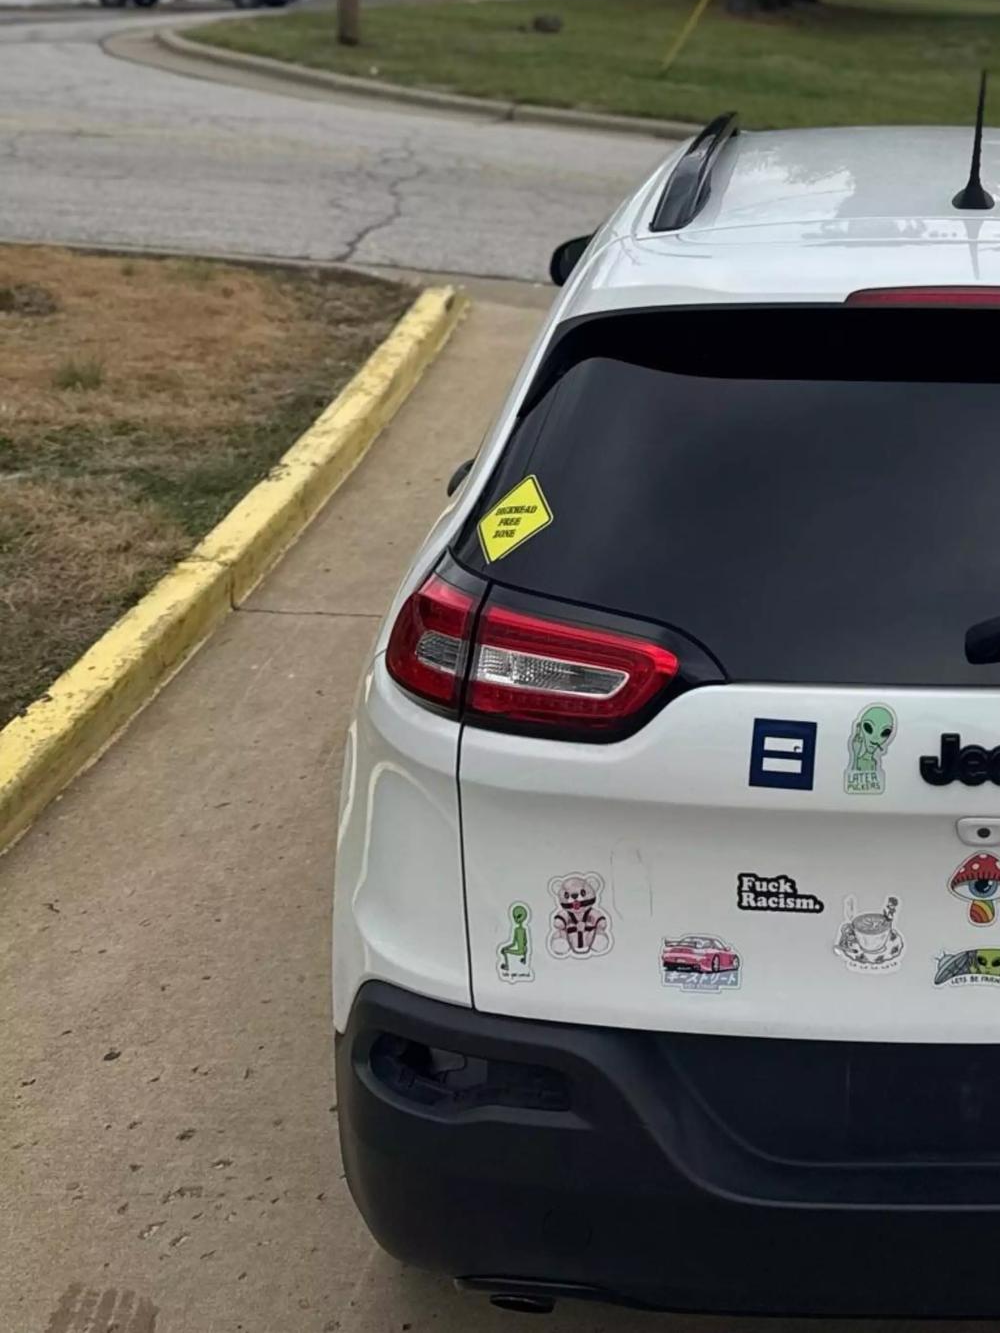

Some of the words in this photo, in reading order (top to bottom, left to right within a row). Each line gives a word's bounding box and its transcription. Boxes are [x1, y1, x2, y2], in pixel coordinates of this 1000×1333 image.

[847, 772, 878, 784] LATER
[741, 877, 794, 893] Fuck
[741, 892, 820, 910] Racism.
